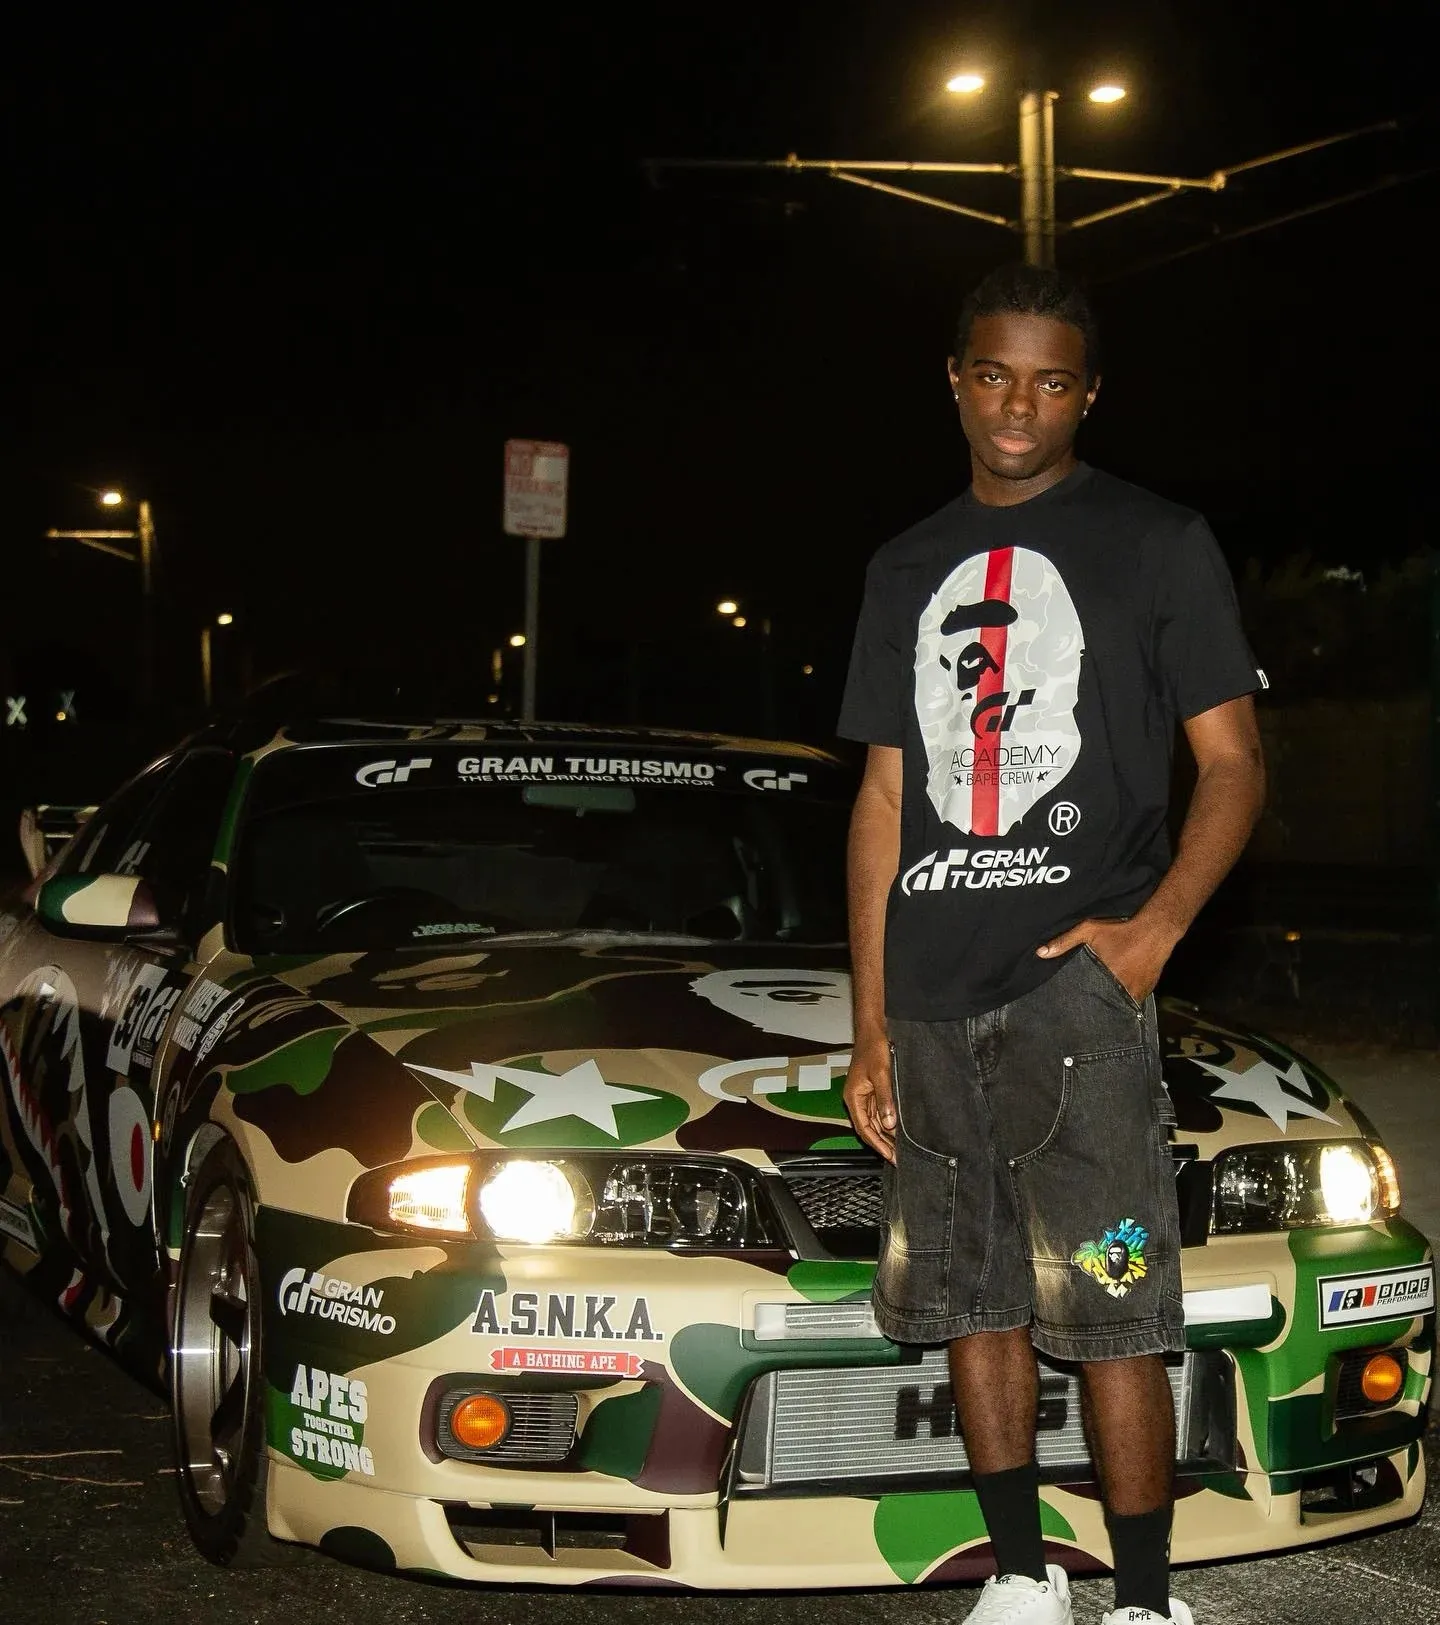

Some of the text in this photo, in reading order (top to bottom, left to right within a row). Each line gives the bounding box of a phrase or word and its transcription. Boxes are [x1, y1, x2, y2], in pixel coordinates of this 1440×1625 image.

[457, 757, 715, 780] GRAN TURISMO
[950, 744, 1062, 770] ACADEMY
[458, 774, 494, 782] THE
[546, 774, 615, 782] DRIVING
[618, 776, 715, 787] SIMULATOR
[966, 770, 1035, 786] BAPE CREW
[970, 846, 1050, 869] GRAN
[950, 865, 1071, 889] TURSMO
[324, 1276, 384, 1310] GRAN
[1376, 1291, 1428, 1307] PERFORMANCE
[1378, 1276, 1431, 1298] BAPE
[309, 1295, 396, 1336] TURISMO
[471, 1289, 664, 1341] A.S.N.K.A.
[512, 1352, 617, 1370] A BATHING APE
[290, 1363, 369, 1424] APES
[302, 1412, 355, 1440] TOGETHER
[290, 1428, 375, 1477] STRONG
